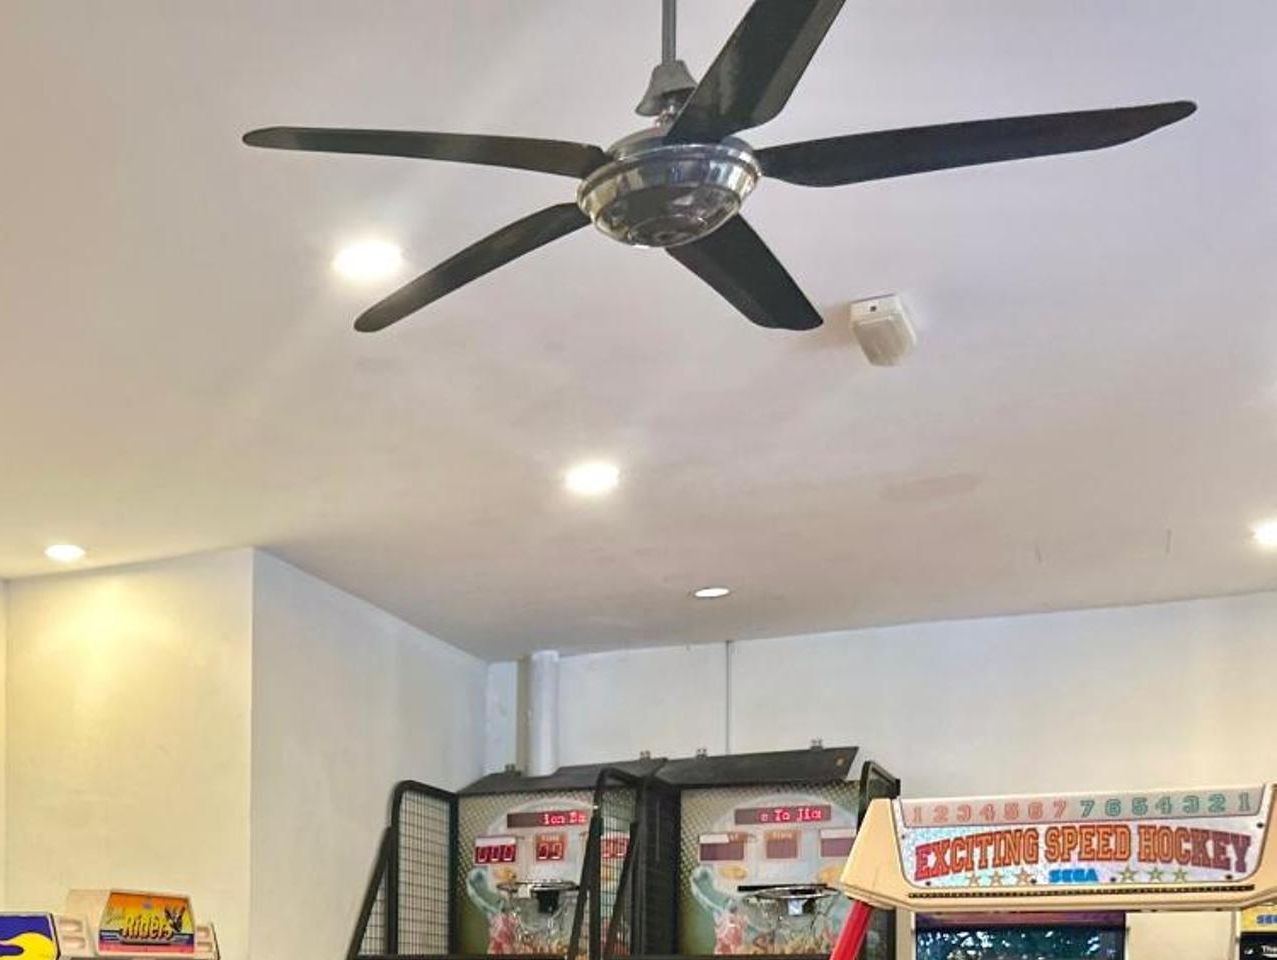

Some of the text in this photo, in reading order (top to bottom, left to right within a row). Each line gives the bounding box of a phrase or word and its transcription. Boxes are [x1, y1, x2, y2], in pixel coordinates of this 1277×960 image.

[913, 792, 1251, 823] 1 2 3 4 5 6 7 7 6 5 4 3 2 1
[914, 824, 1252, 882] EXCITING SPEED HOCKEY
[1048, 868, 1098, 883] SEGA
